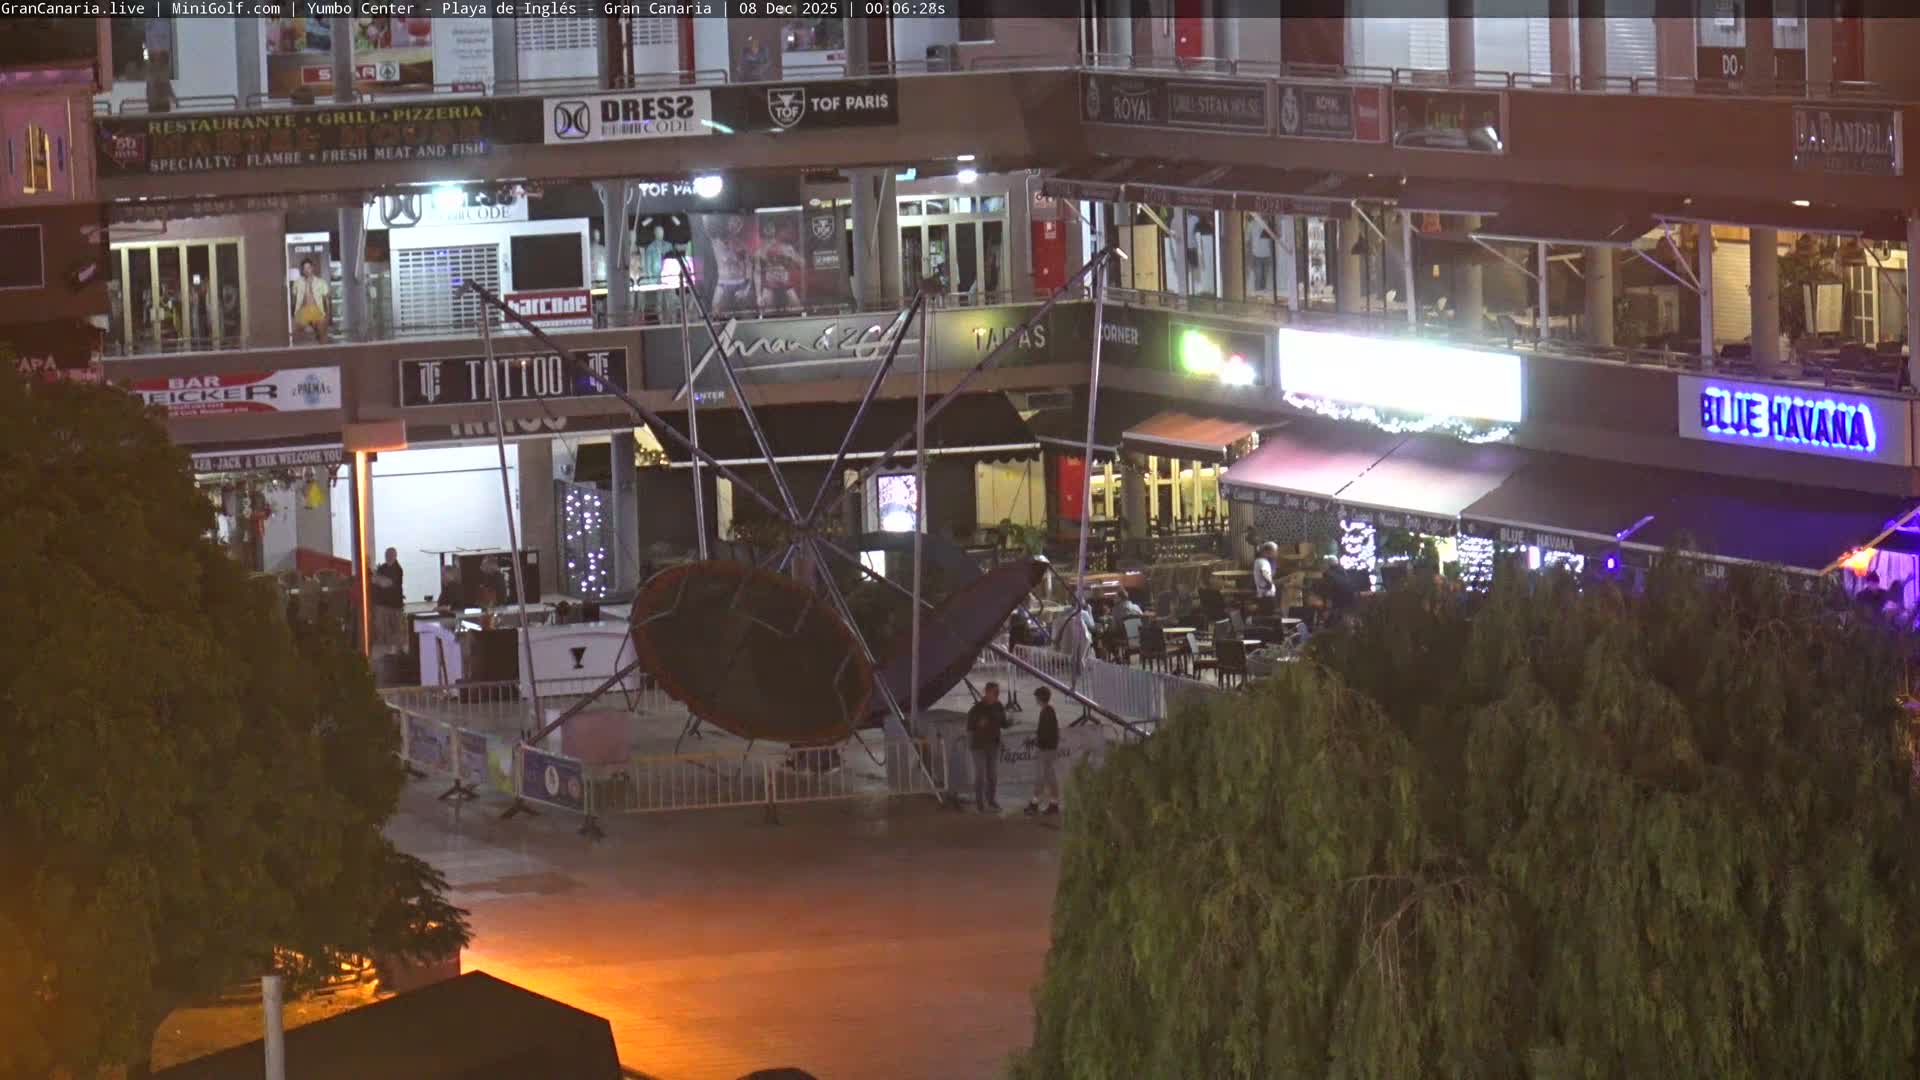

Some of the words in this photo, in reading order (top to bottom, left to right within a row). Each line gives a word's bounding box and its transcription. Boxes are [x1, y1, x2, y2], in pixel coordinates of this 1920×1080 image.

[601, 95, 694, 122] DRESS
[811, 96, 841, 112] TOF
[845, 94, 889, 110] PARIS
[149, 115, 297, 136] RESTAURANTE
[317, 110, 380, 126] GRILL
[392, 105, 483, 122] PIZZERIA
[775, 106, 798, 119] TOF
[322, 149, 368, 163] FRESH
[374, 147, 412, 161] MEAT
[416, 145, 447, 158] AND
[452, 143, 485, 156] FISH
[639, 182, 669, 197] TOF
[168, 376, 220, 389] BAR
[1701, 386, 1768, 438] BLUE
[1769, 395, 1876, 452] HAVANA
[278, 450, 322, 465] WELCOME
[323, 448, 343, 462] YOU
